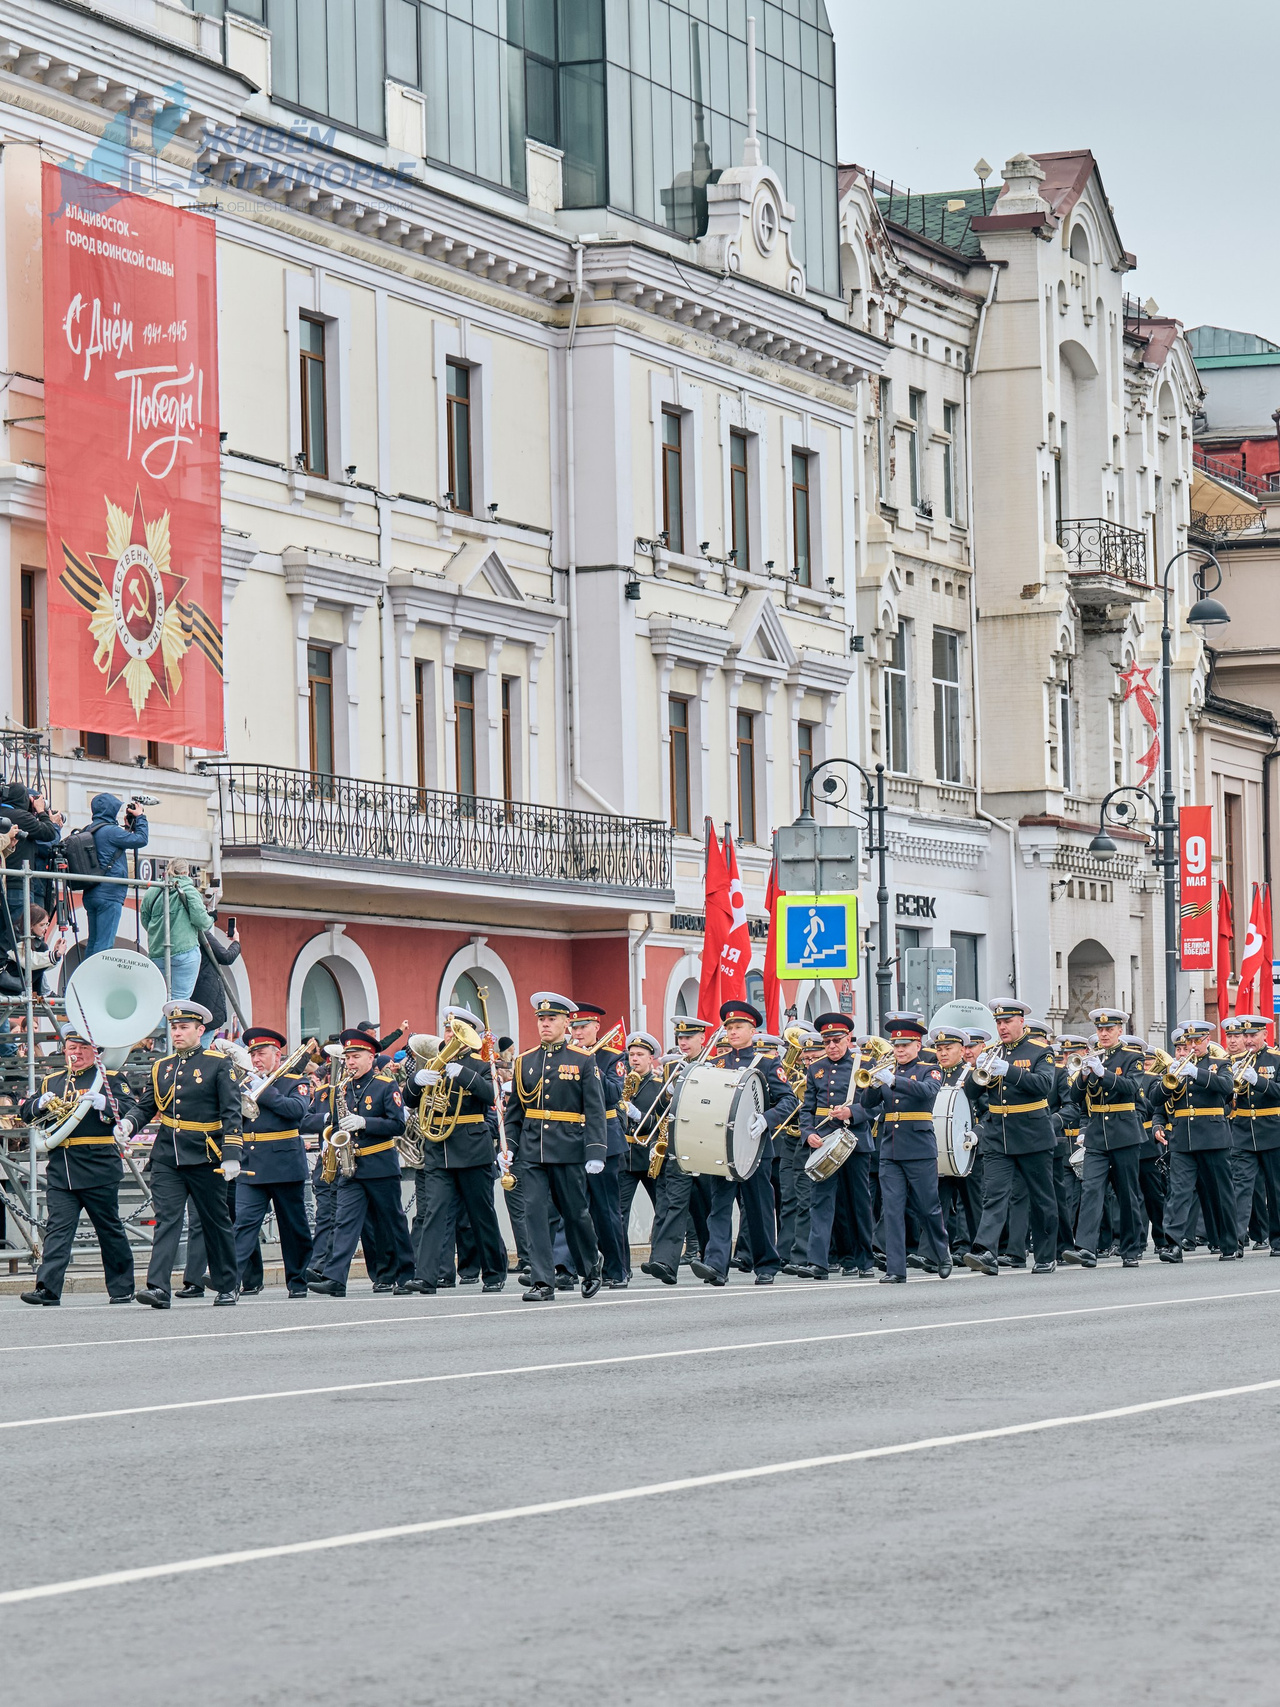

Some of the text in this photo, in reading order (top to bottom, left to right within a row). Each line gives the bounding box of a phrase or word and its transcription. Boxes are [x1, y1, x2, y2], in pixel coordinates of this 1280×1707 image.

[65, 202, 130, 237] ВЛАДИВОСТОК
[65, 229, 175, 278] ГОРОД ВОИНСКОЙ СЛАВЫ
[84, 297, 133, 381] Днём
[115, 362, 204, 480] Победы!
[1185, 835, 1206, 874] 9
[1186, 876, 1207, 887] МАЯ
[896, 893, 937, 919] BORK
